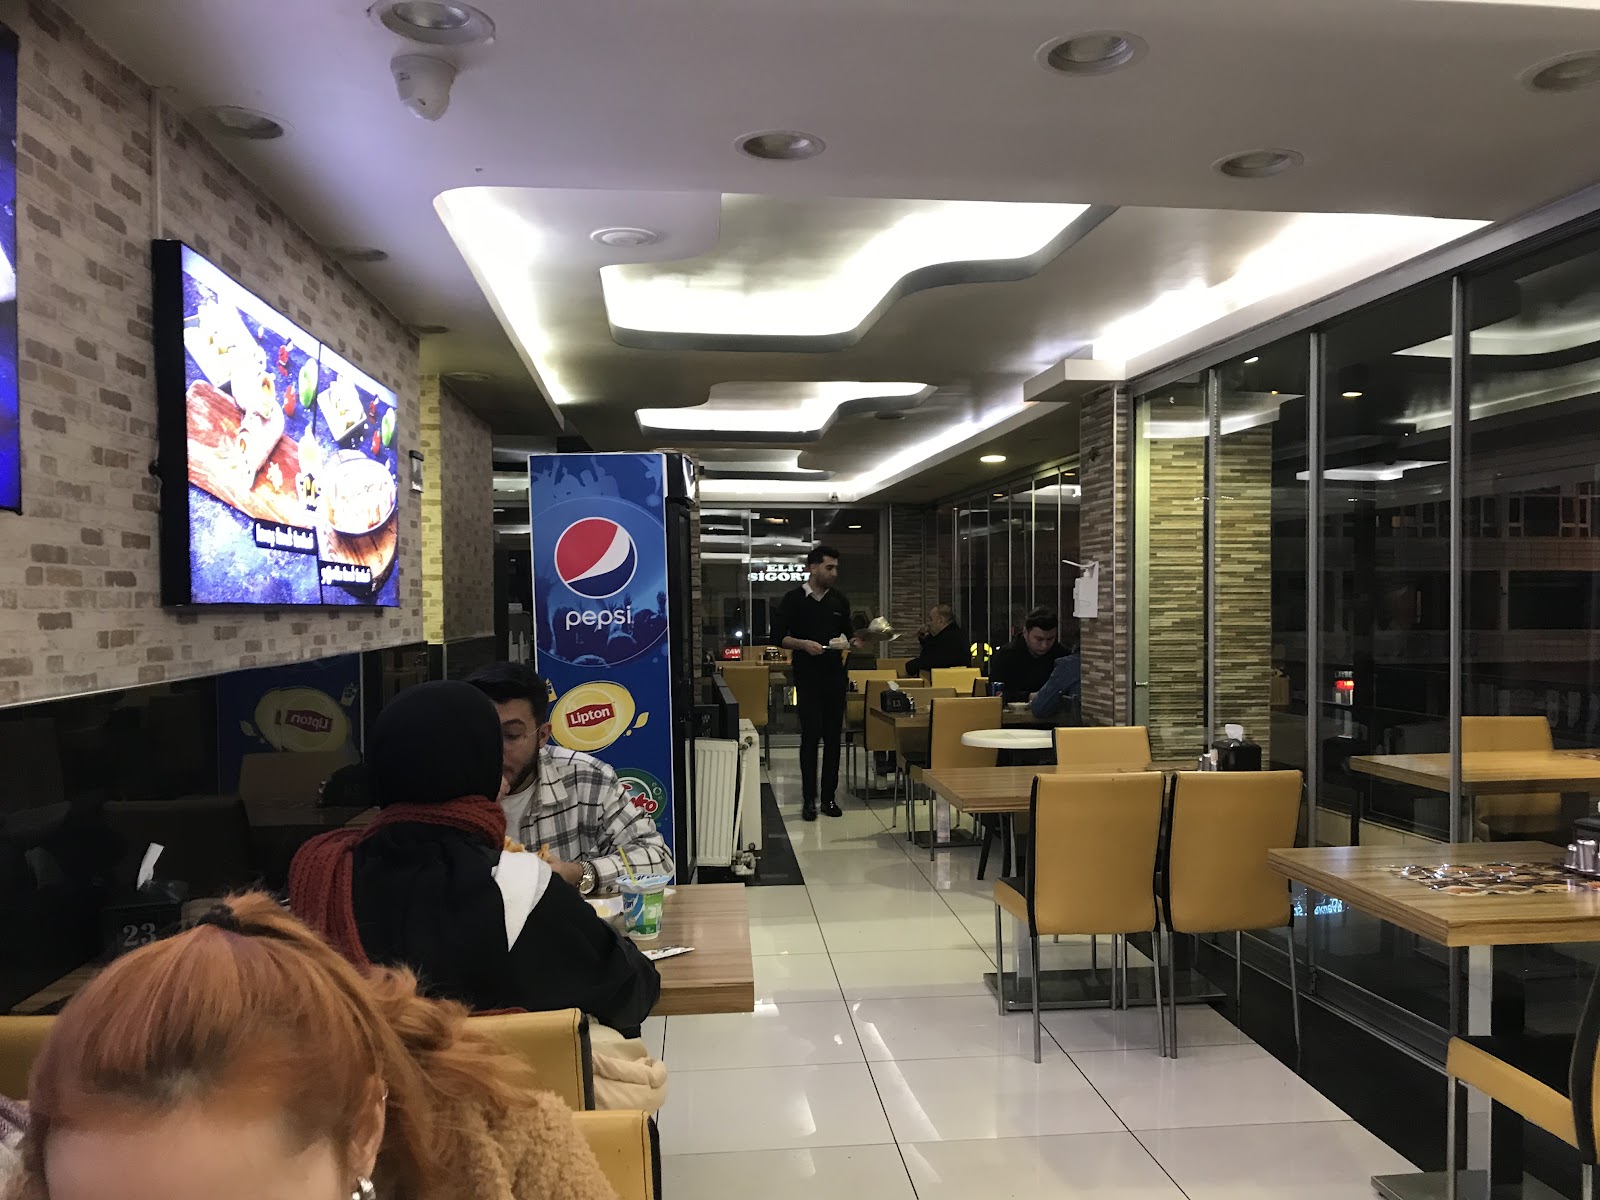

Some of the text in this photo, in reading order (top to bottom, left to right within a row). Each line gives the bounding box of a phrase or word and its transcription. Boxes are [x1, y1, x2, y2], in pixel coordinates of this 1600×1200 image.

[747, 570, 811, 582] SİGORT
[766, 562, 806, 572] ELİT
[565, 605, 631, 630] pepsi
[570, 707, 610, 725] Lipton
[122, 922, 157, 947] 23
